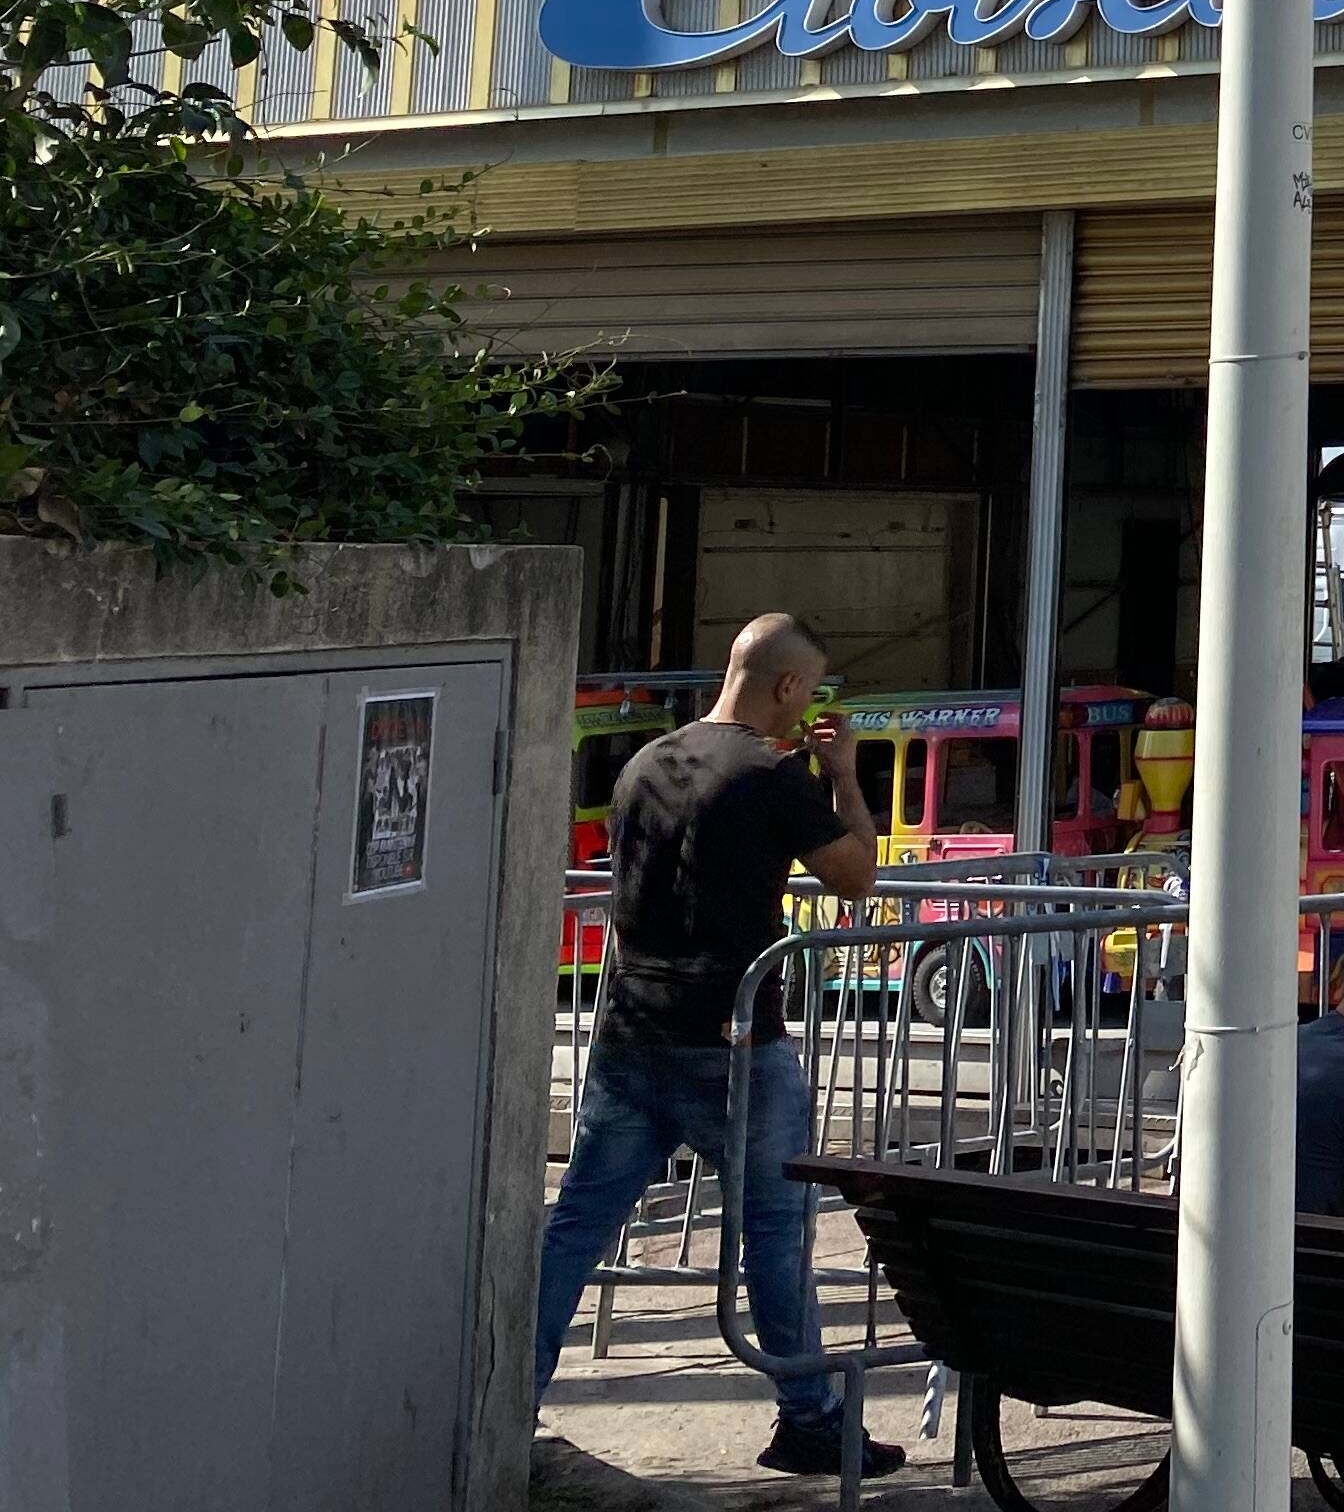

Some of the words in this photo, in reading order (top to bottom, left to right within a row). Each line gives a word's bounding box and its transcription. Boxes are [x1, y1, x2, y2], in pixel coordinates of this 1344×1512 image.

[850, 711, 891, 731] BUS
[900, 707, 1001, 730] WARNER
[1088, 705, 1130, 723] BUS
